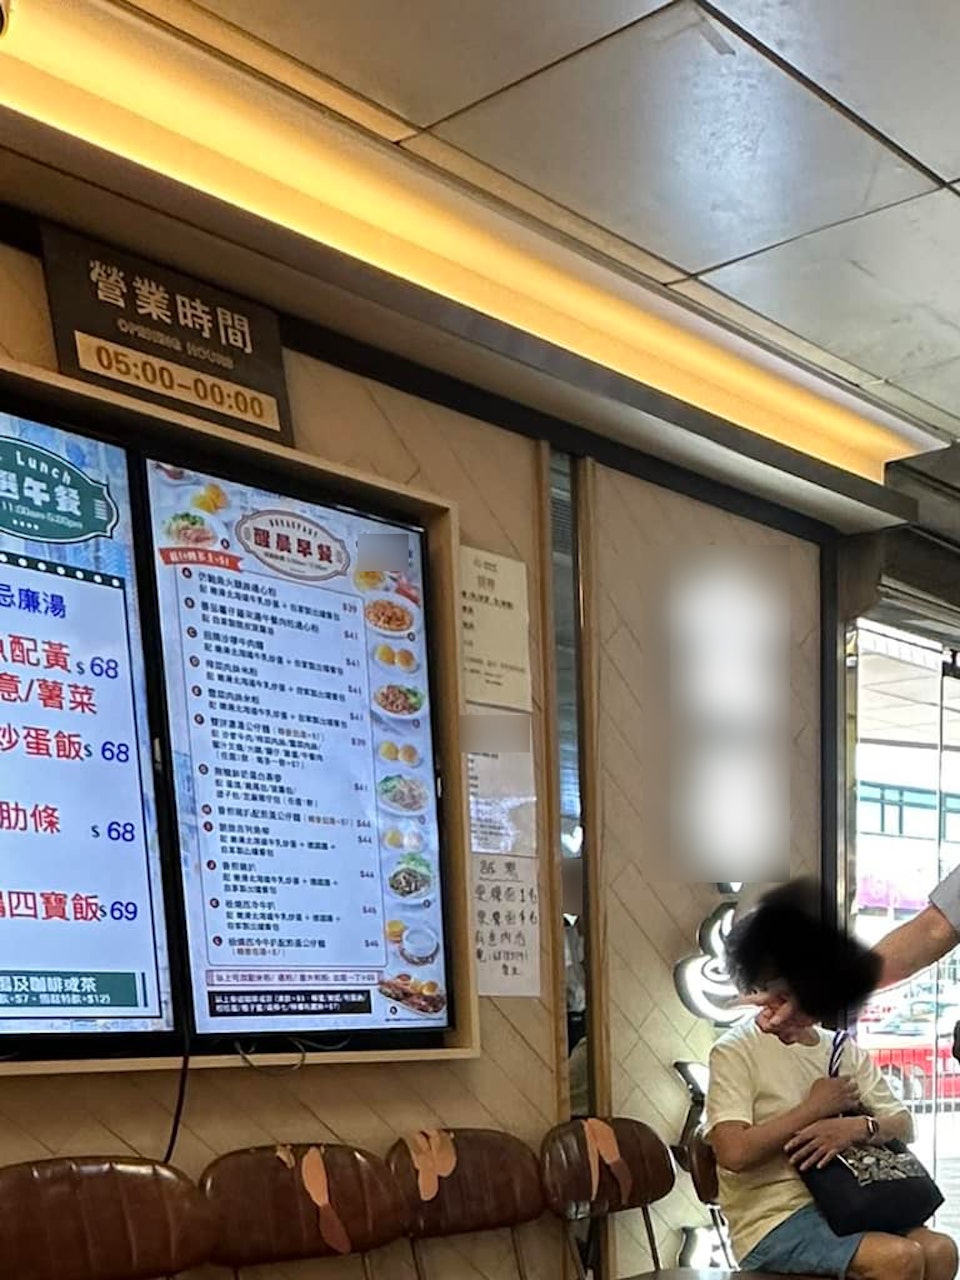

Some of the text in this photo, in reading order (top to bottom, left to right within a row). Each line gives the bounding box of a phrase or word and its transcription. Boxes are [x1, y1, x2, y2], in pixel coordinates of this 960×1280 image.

[90, 260, 253, 354] 營業時間
[96, 346, 263, 419] 05:00-00:00
[16, 450, 71, 486] Lunch
[0, 723, 84, 761] 炒蛋飯
[0, 890, 101, 921] 四寶飯
